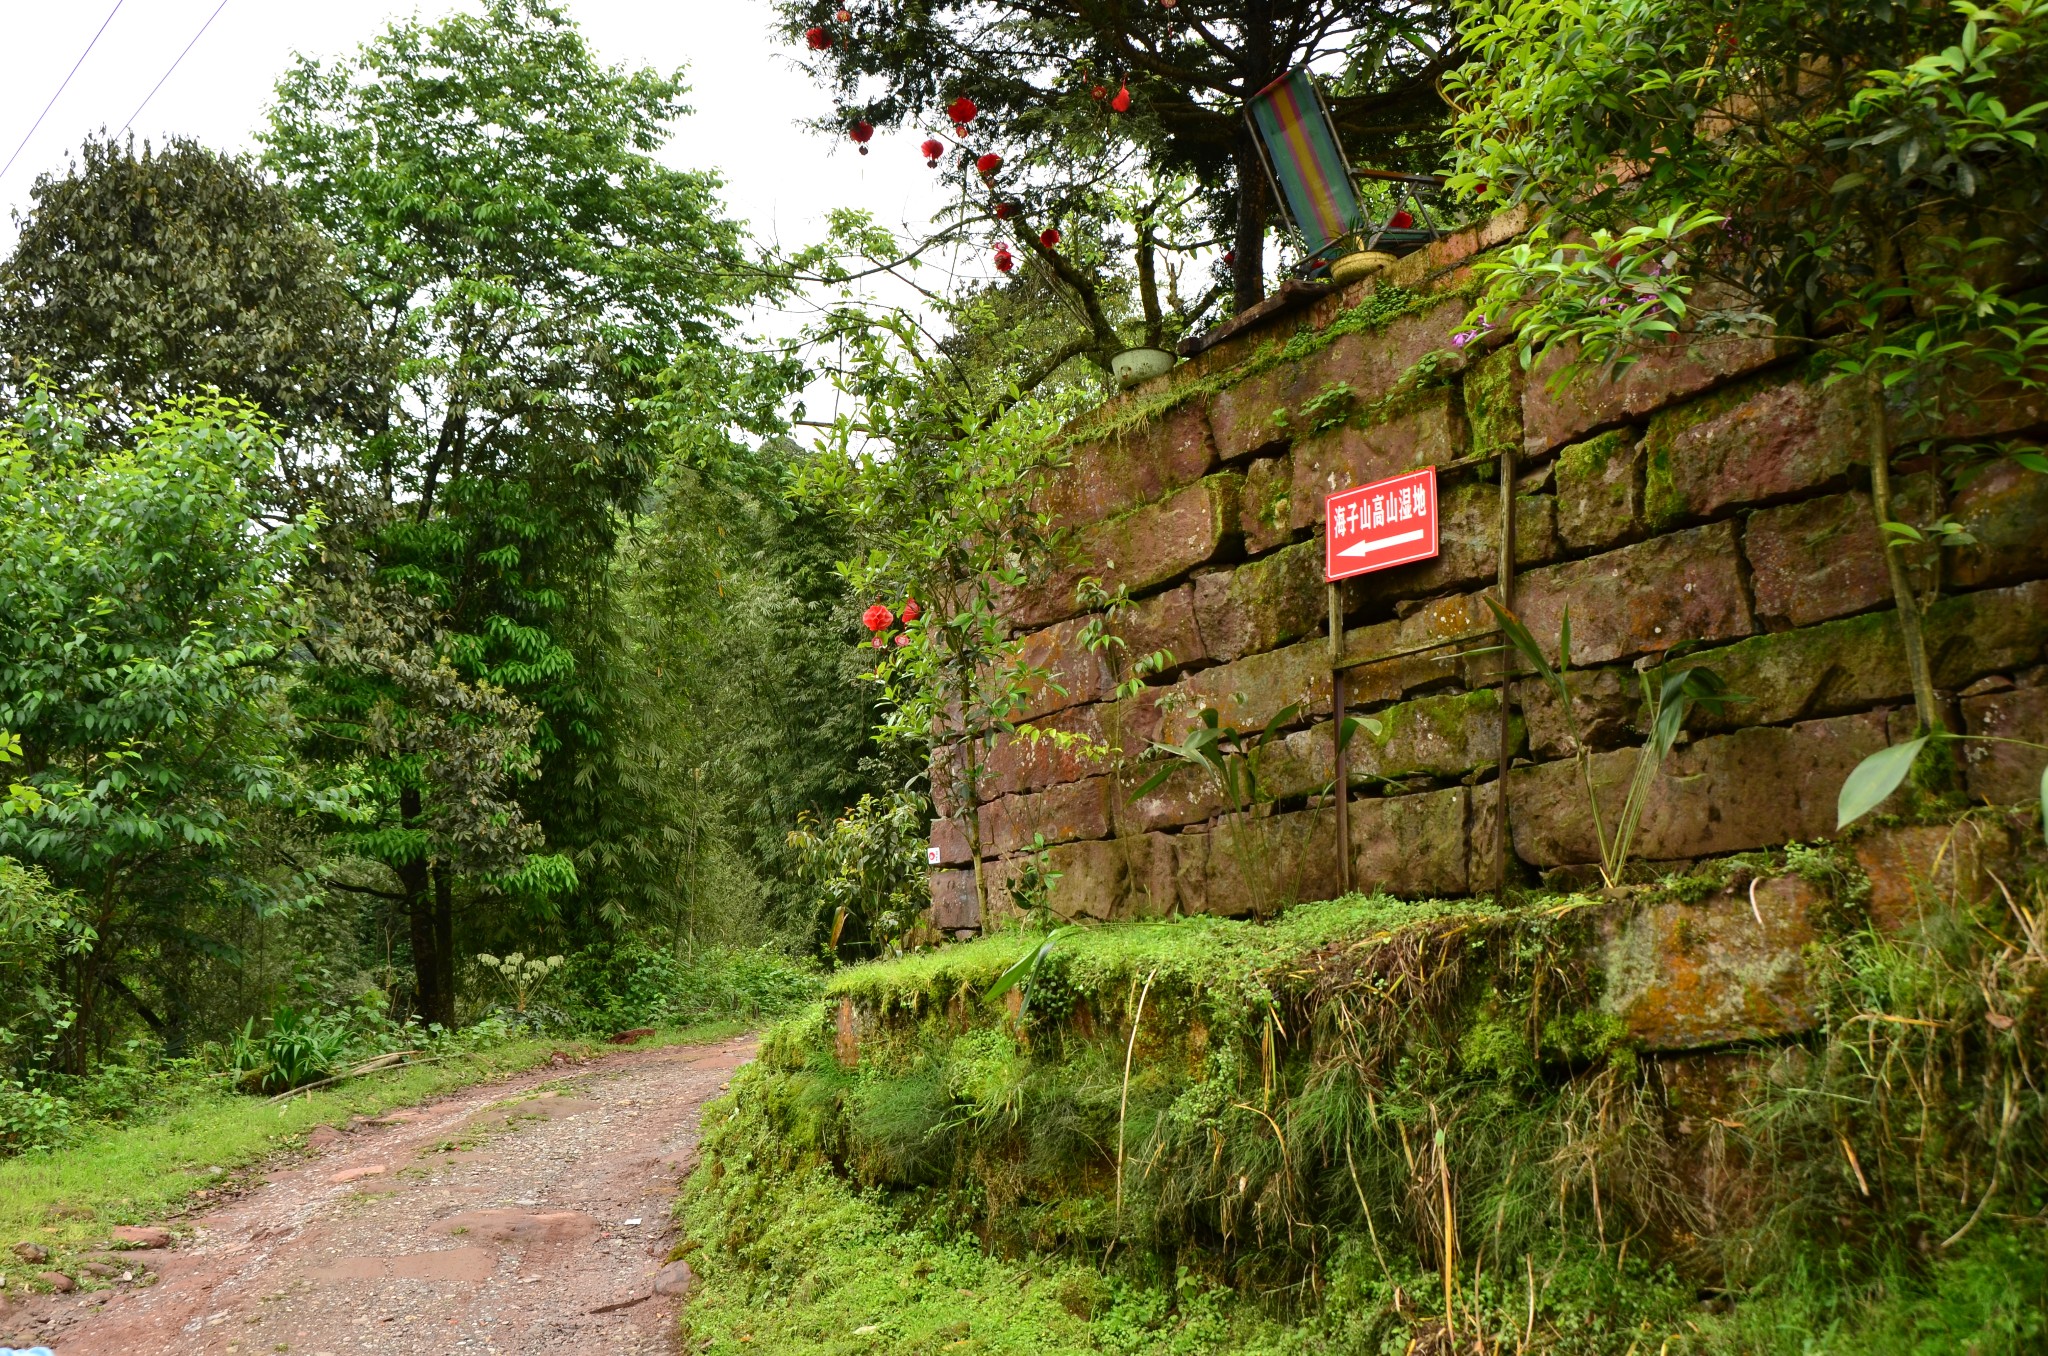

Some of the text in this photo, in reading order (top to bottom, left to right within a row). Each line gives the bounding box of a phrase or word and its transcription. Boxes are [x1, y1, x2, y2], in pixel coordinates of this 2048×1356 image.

[1334, 483, 1426, 538] 海子山高山湿地
